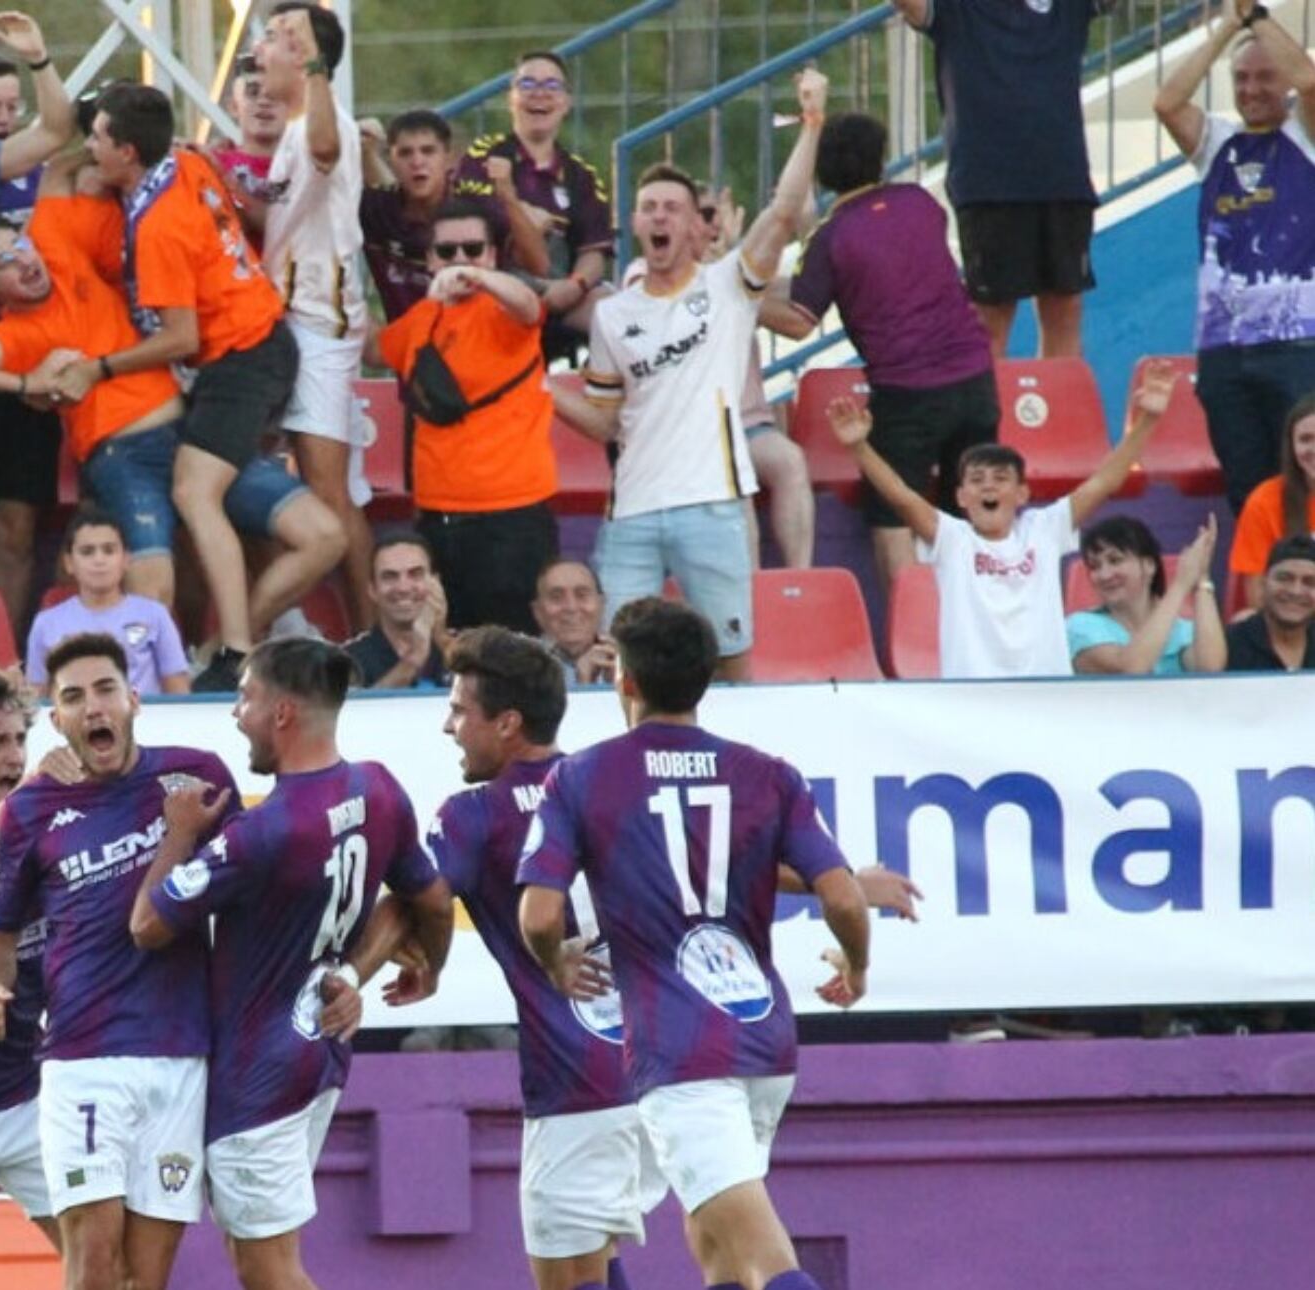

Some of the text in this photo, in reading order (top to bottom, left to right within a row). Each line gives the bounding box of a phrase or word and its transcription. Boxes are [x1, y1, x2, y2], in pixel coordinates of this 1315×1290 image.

[645, 751, 718, 778] ROBERT
[648, 784, 731, 918] 17
[78, 1103, 99, 1155] 7
